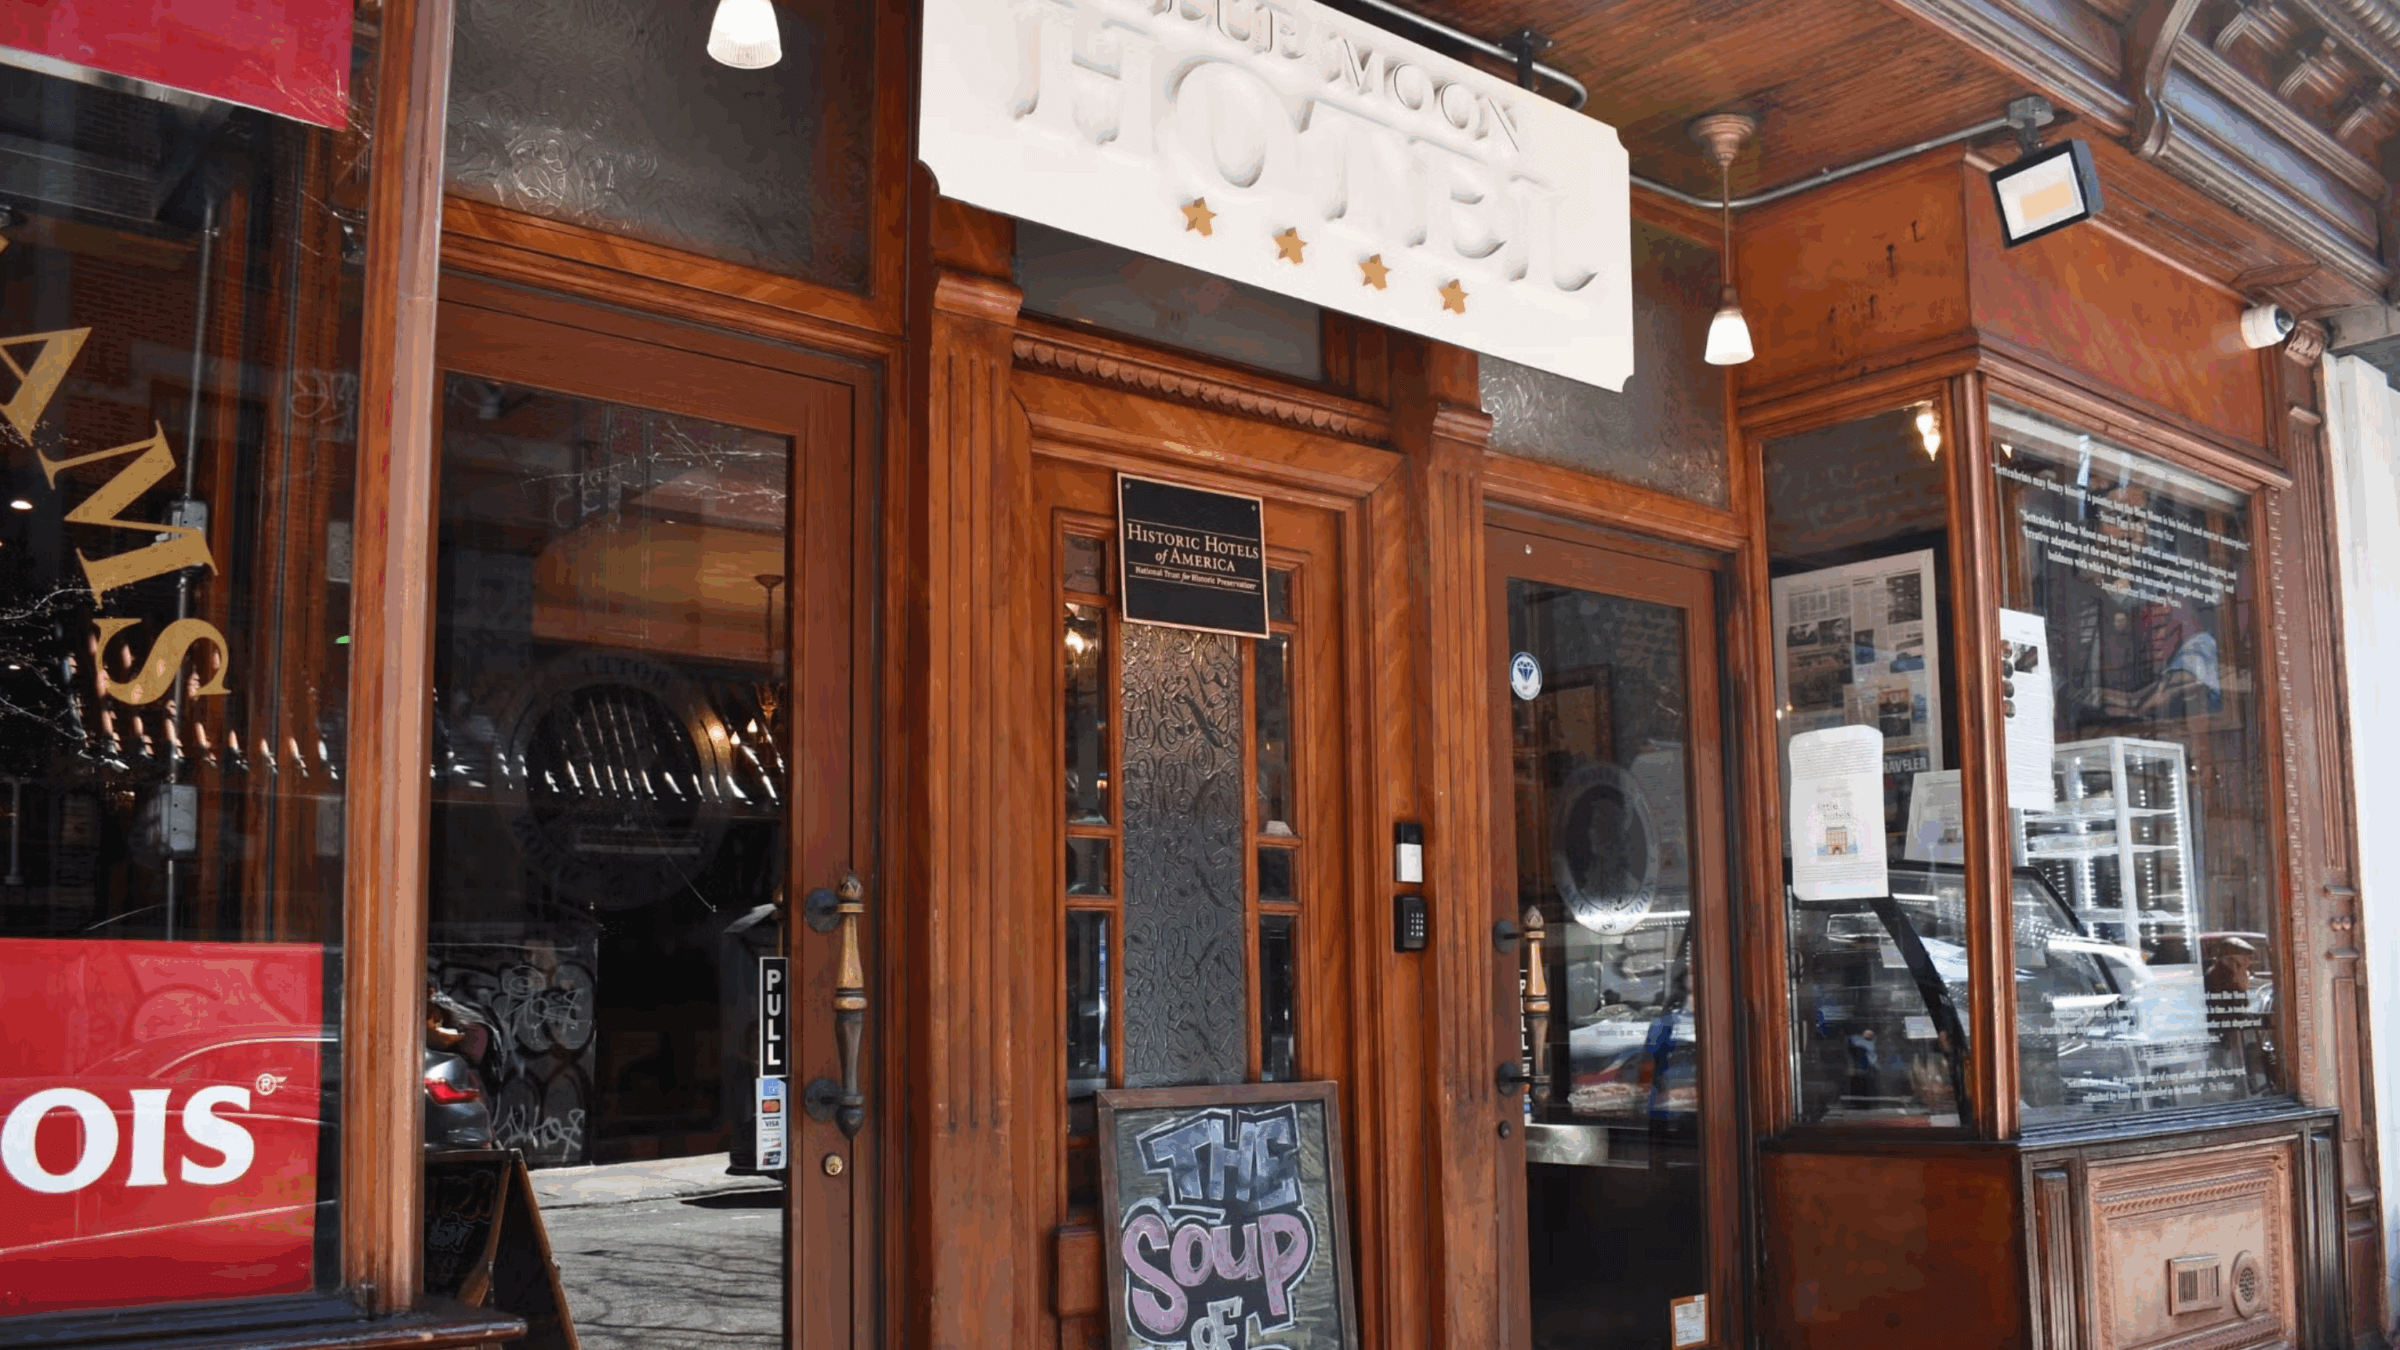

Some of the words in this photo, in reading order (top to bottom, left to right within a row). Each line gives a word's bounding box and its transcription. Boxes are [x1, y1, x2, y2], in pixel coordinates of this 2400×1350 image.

[1323, 31, 1521, 153] MOON
[1003, 0, 1598, 292] HOTEL
[0, 236, 231, 705] AMS
[1127, 523, 1200, 550] HISTORIC
[1205, 535, 1259, 559] HOTELS
[1135, 566, 1163, 578] National
[1164, 570, 1181, 579] Trust
[1191, 574, 1216, 585] Historic
[1155, 549, 1168, 564] of
[1170, 548, 1236, 573] AMERICA
[766, 969, 782, 1065] PULL
[1149, 1116, 1298, 1211] THE
